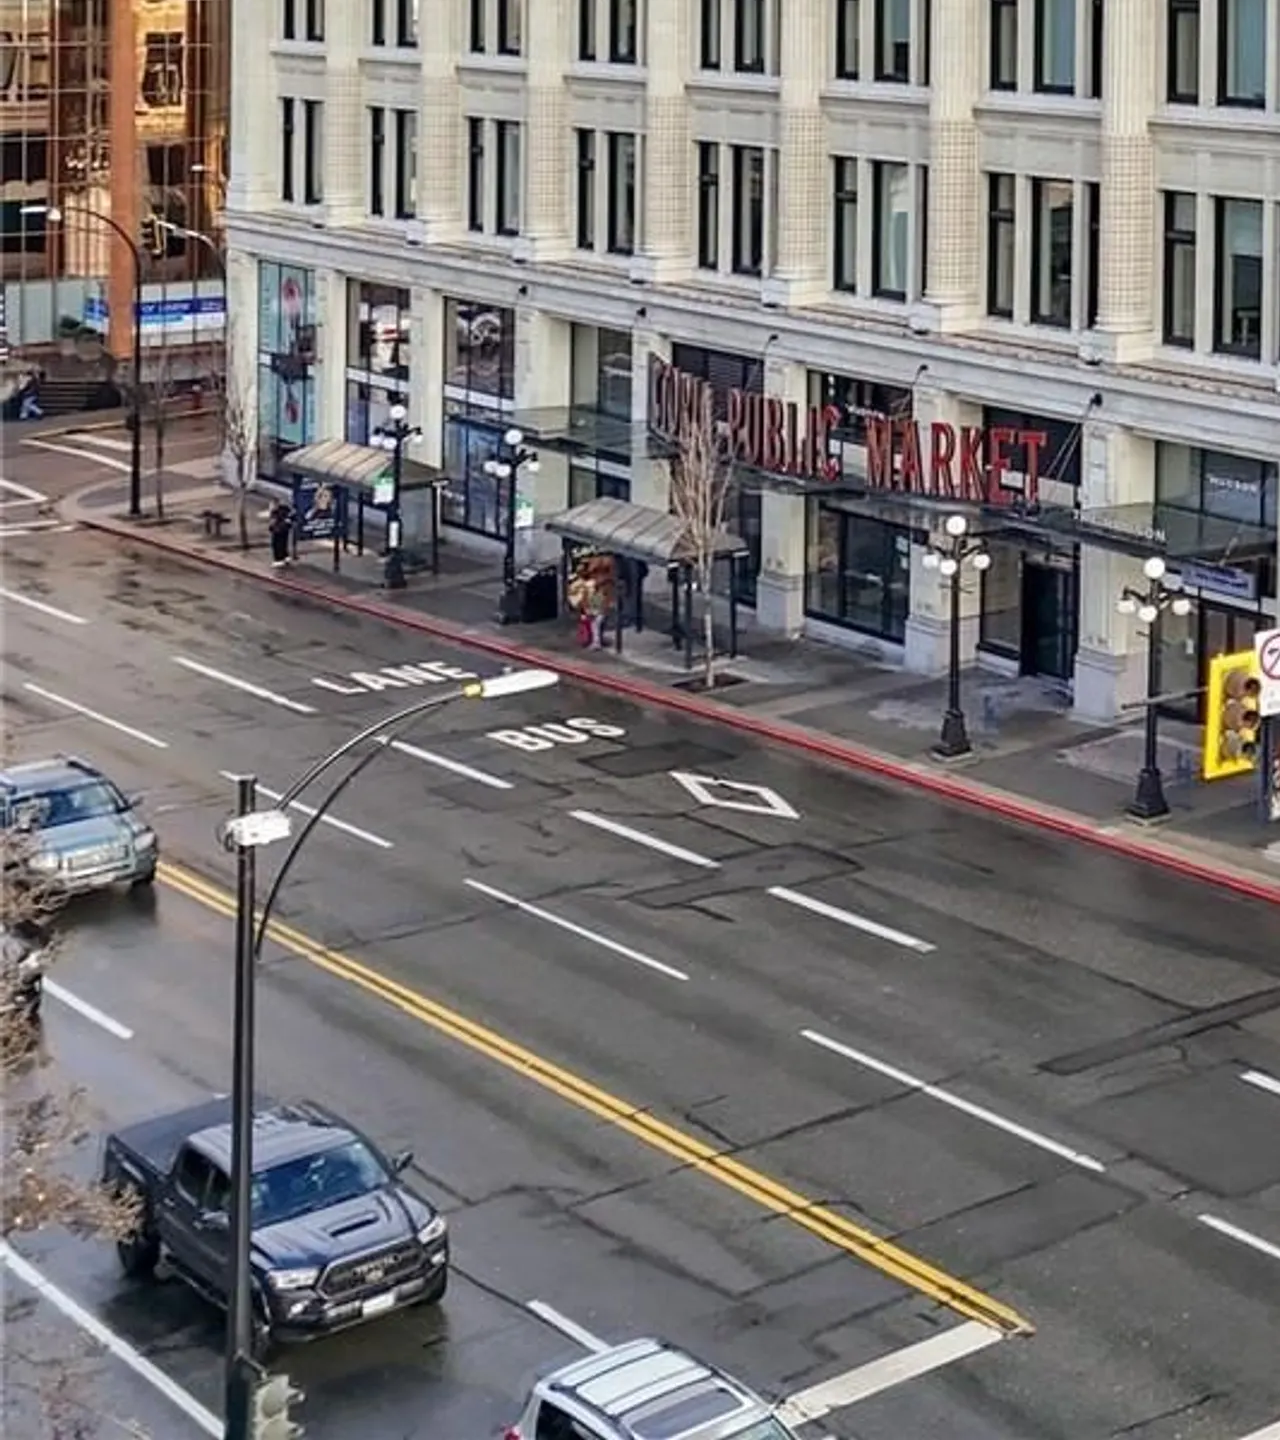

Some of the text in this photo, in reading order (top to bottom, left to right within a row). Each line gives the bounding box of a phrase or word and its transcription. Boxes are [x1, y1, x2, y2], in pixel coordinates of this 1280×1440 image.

[729, 386, 842, 482] PUBLIC
[865, 414, 1047, 508] MARKET
[311, 661, 482, 695] LANE
[486, 717, 626, 751] BUS
